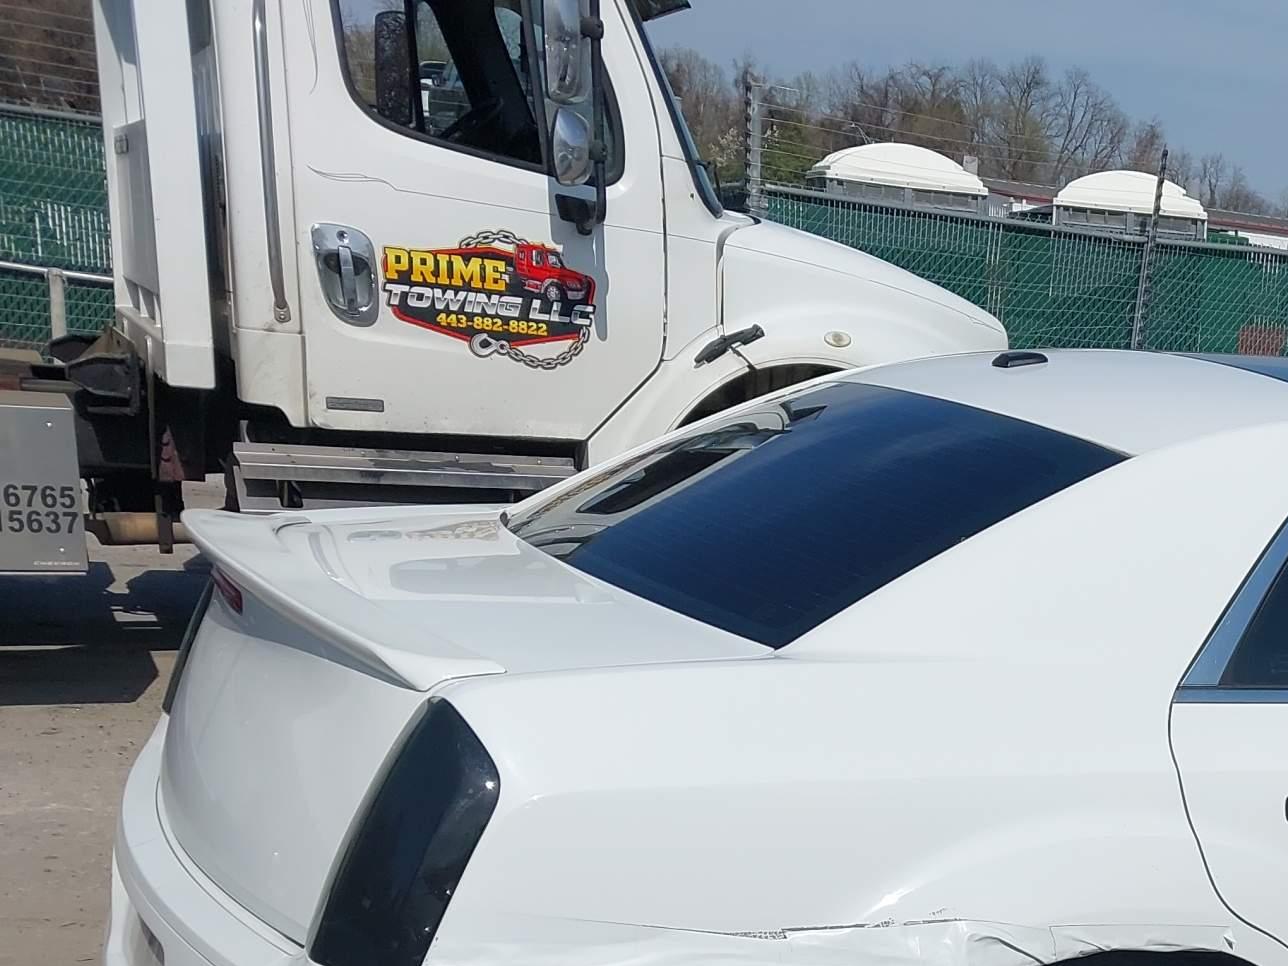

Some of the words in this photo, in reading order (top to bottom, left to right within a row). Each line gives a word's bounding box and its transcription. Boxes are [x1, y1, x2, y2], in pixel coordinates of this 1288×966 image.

[384, 248, 506, 291] PRIME
[384, 284, 523, 317] TOWING
[528, 300, 596, 326] LLC
[436, 313, 548, 336] 443-882-8822
[3, 484, 76, 508] 6765
